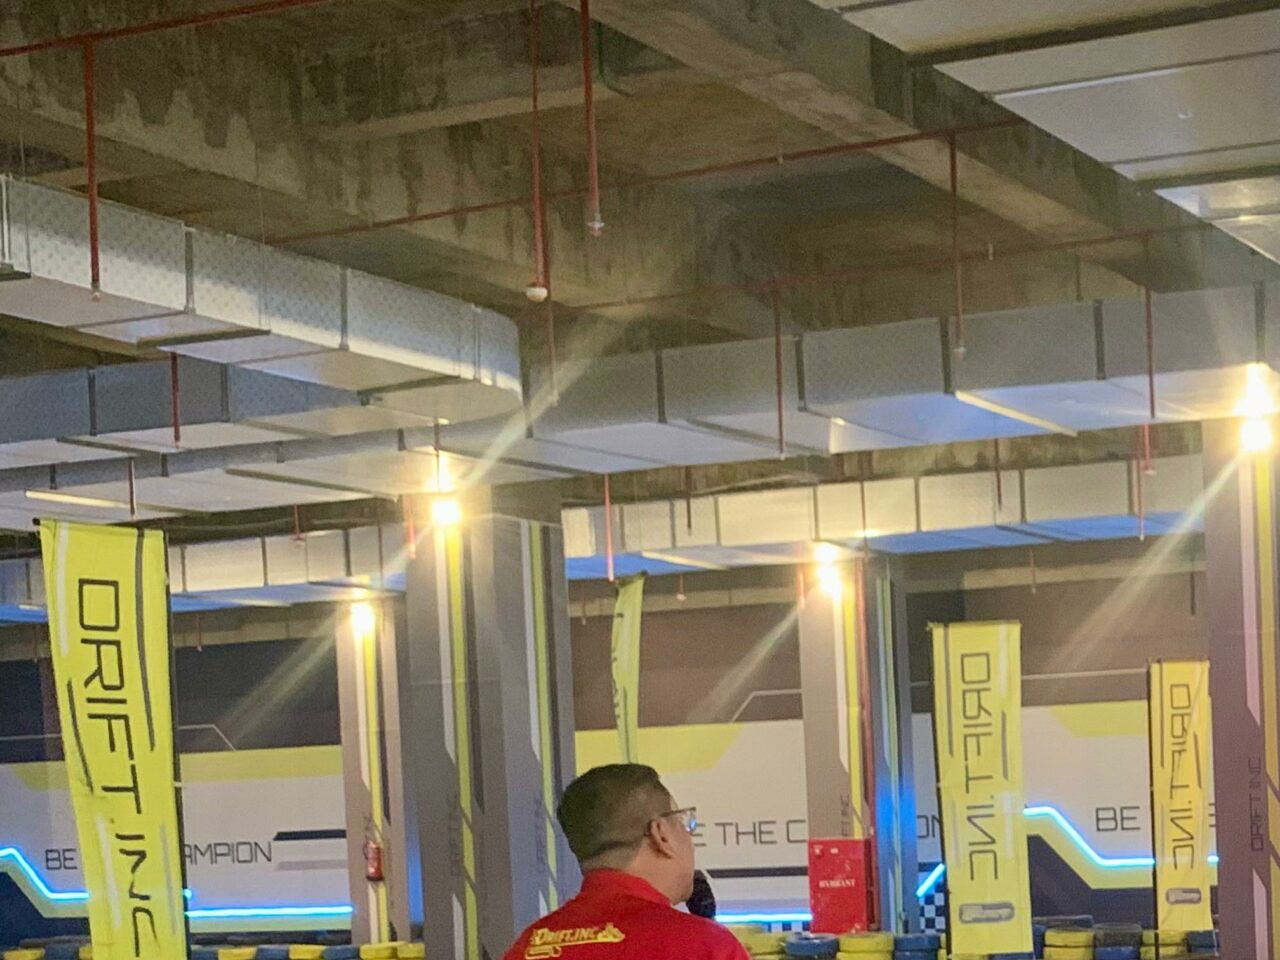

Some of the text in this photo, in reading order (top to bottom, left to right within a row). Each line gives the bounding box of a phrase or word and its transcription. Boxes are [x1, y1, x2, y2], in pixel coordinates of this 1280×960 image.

[1095, 806, 1141, 832] BE
[714, 820, 777, 846] THE
[45, 841, 272, 870] BE AMPION
